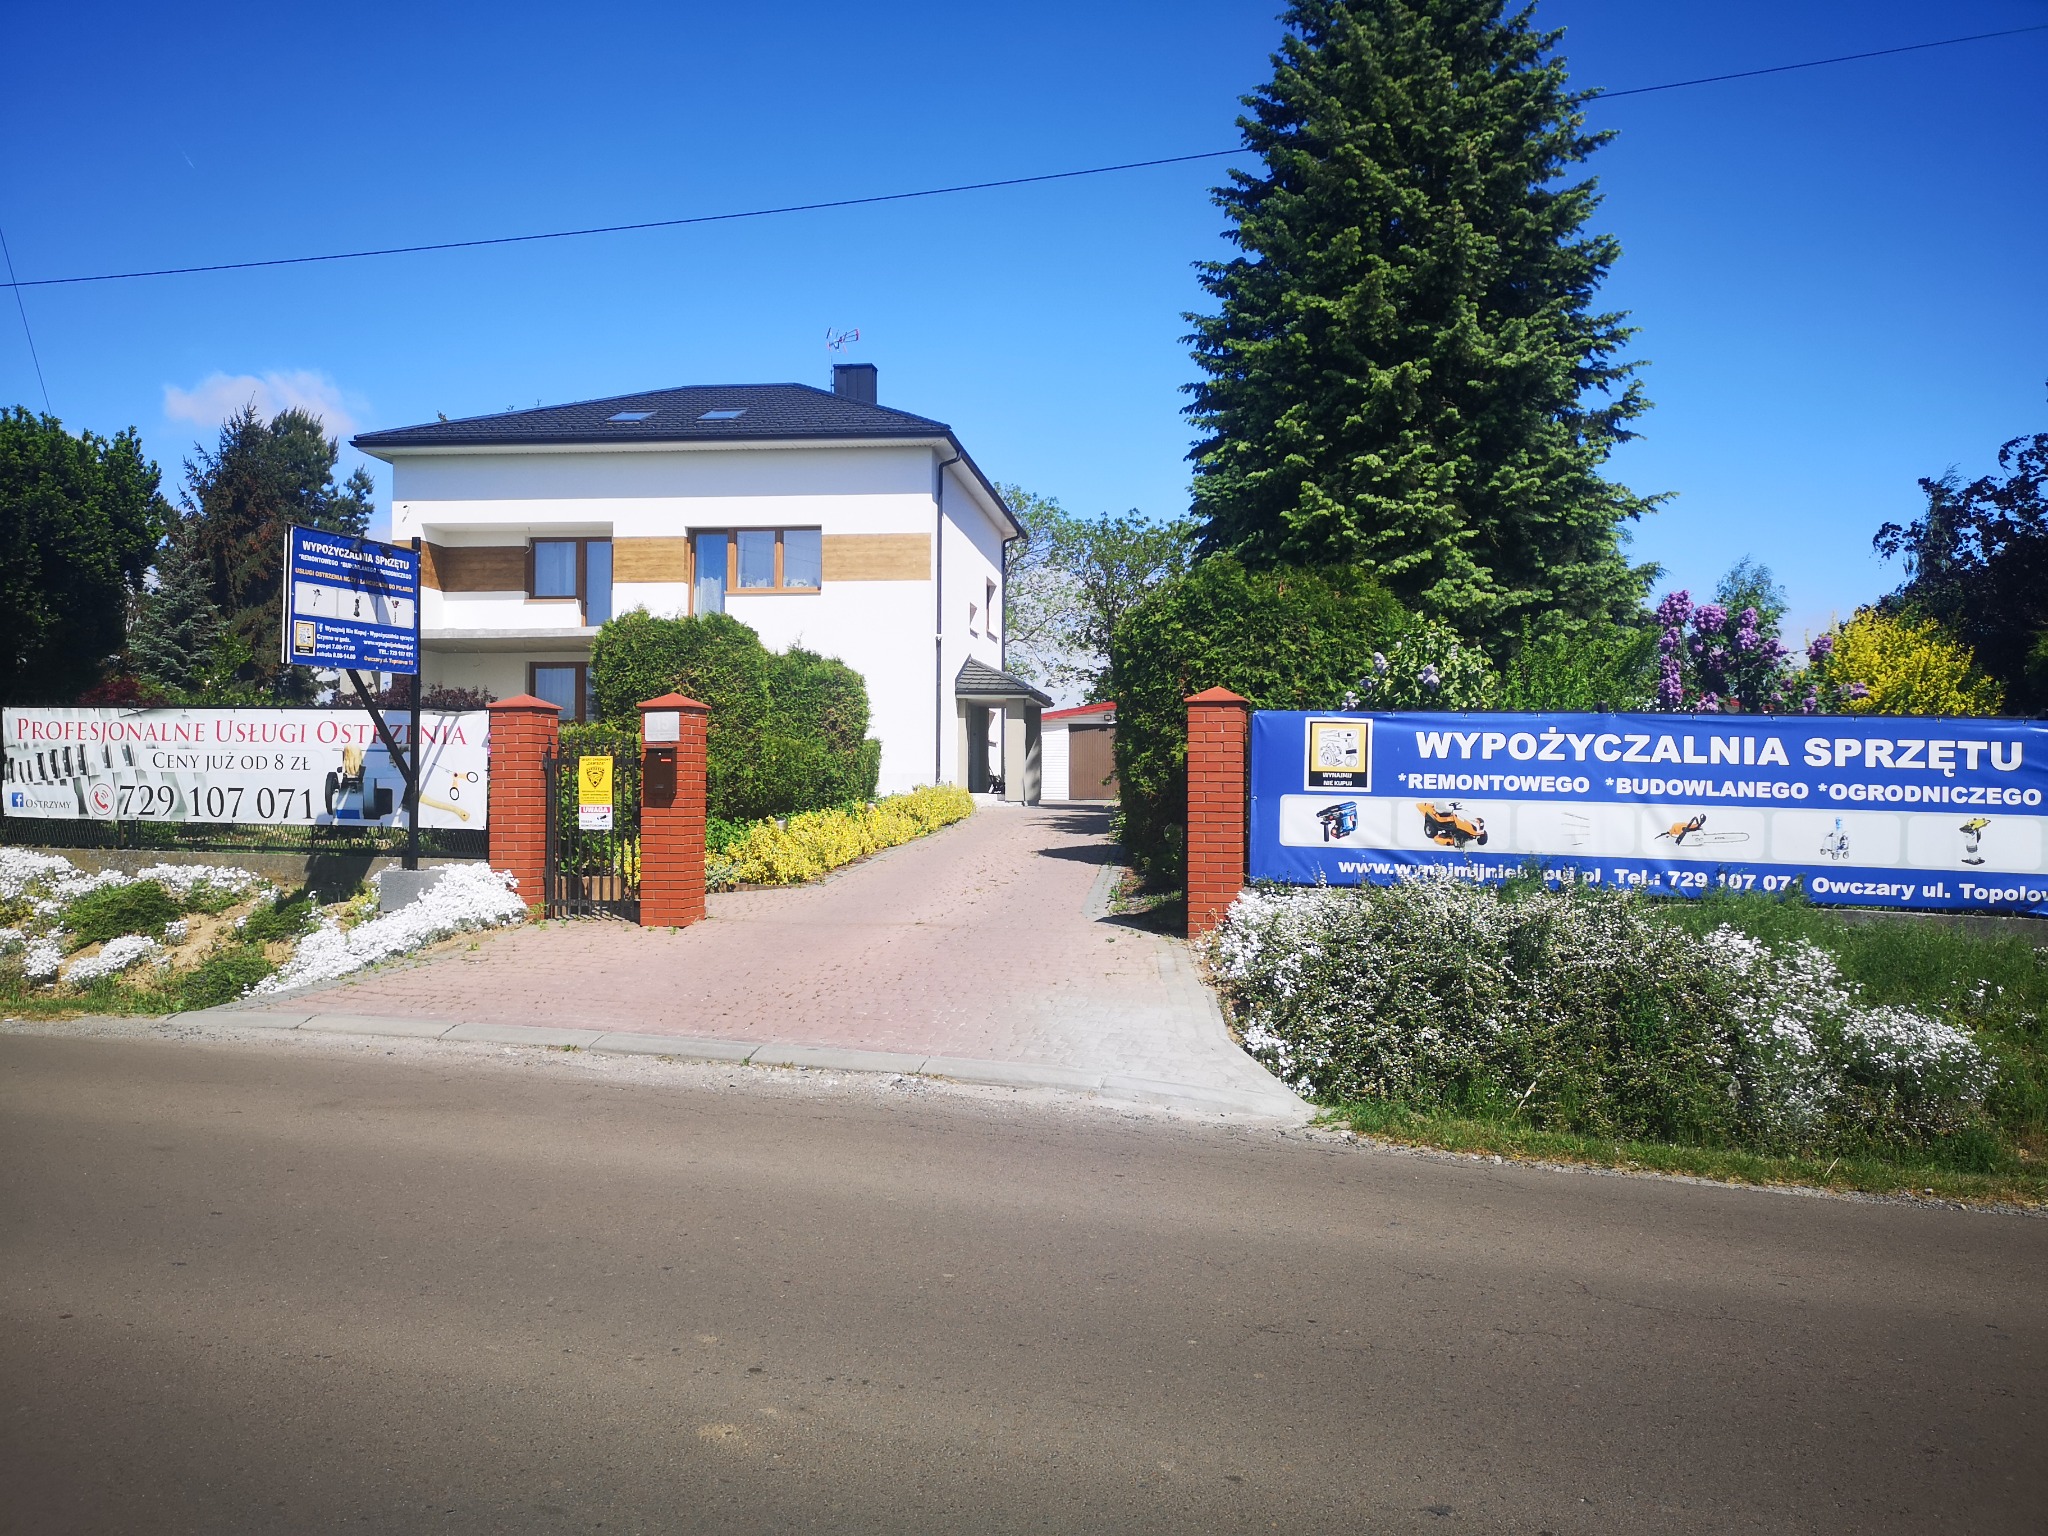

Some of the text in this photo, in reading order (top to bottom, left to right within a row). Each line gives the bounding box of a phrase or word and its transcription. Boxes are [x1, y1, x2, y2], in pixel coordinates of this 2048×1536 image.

[302, 540, 410, 572] WYPOŻYCZALNIA SPRZĘTU
[17, 718, 206, 745] PROFESJONALNE
[215, 720, 306, 743] USŁUGI
[152, 752, 311, 772] CENY JUŻ OD 8 ZŁ
[1416, 726, 2023, 777] WYPOŻYCZALNIA SPRZĘTU
[25, 799, 72, 809] OSTRZYMY
[119, 785, 316, 820] 729 107 071
[1668, 871, 1708, 887] 729
[1717, 873, 1756, 890] 107
[1812, 877, 1916, 900] Owczary
[1923, 882, 1950, 898] ul.
